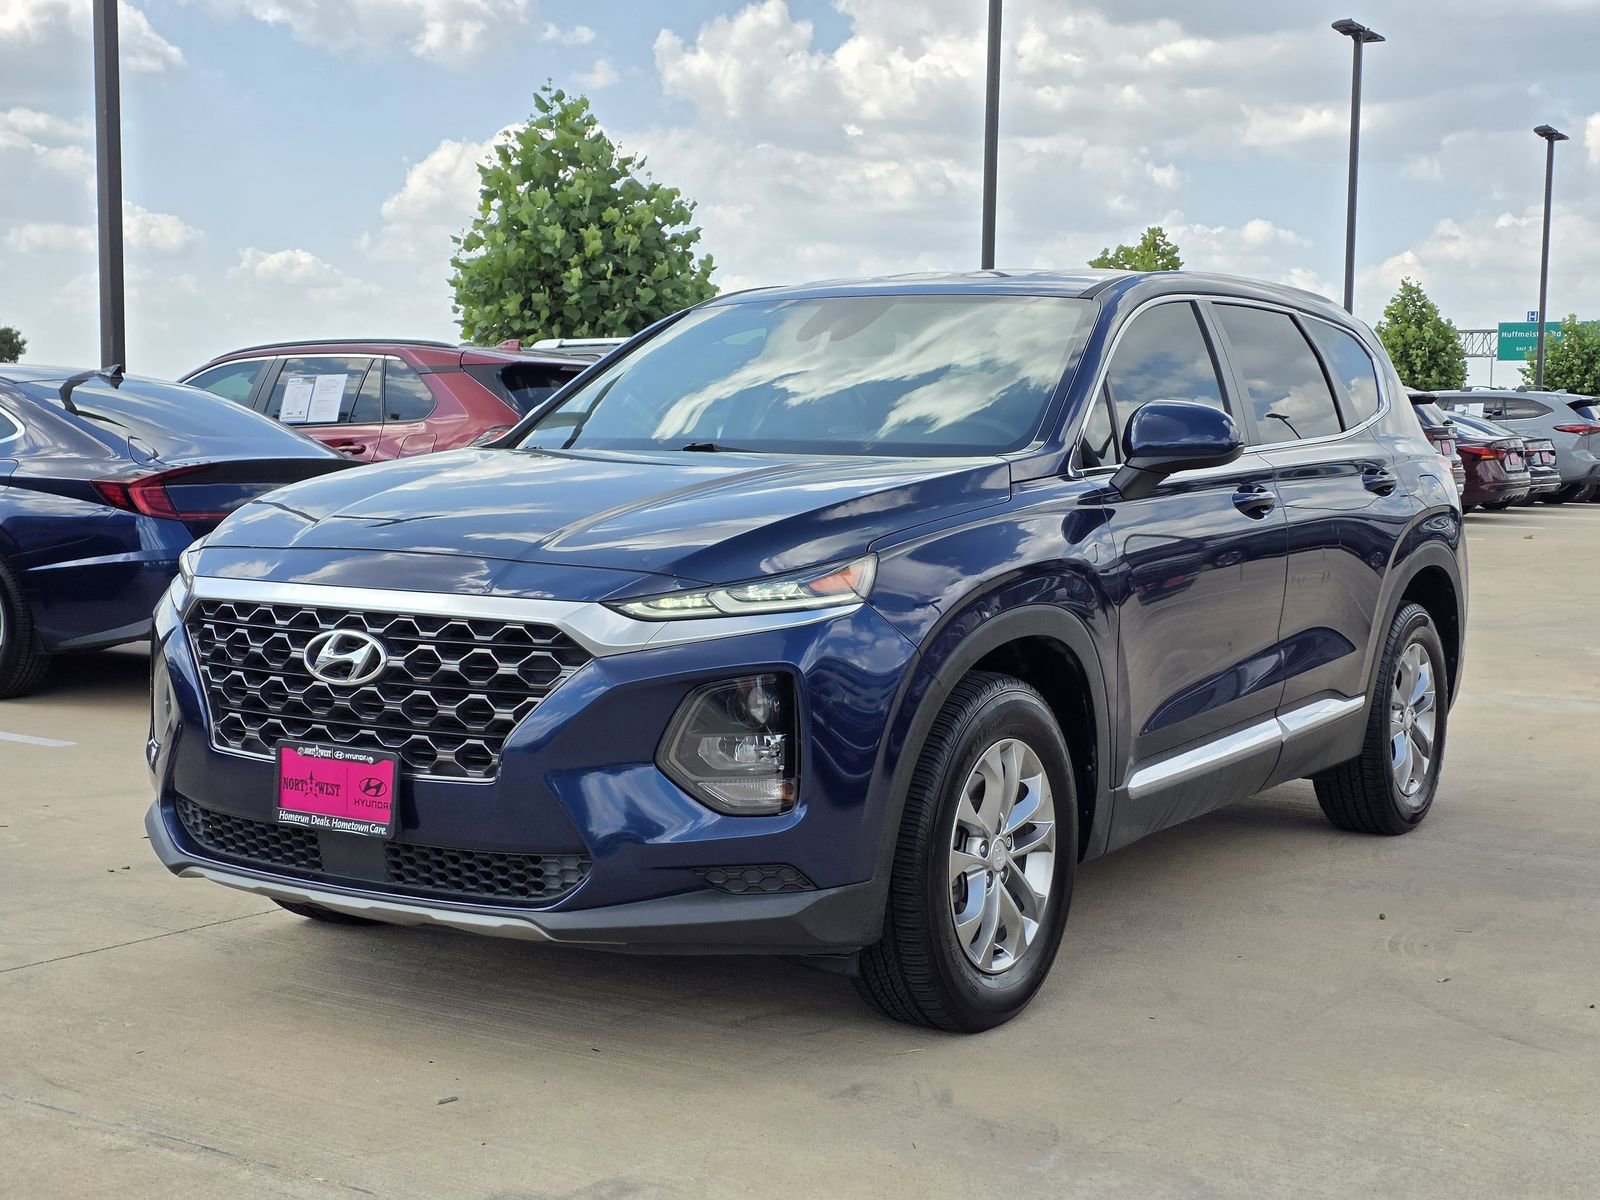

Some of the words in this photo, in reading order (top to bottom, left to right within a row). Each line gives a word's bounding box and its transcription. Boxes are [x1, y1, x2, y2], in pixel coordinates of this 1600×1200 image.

[278, 809, 309, 824] Homerun
[310, 815, 330, 828] Deals.
[331, 818, 369, 833] Hometown
[369, 823, 387, 836] Care.
